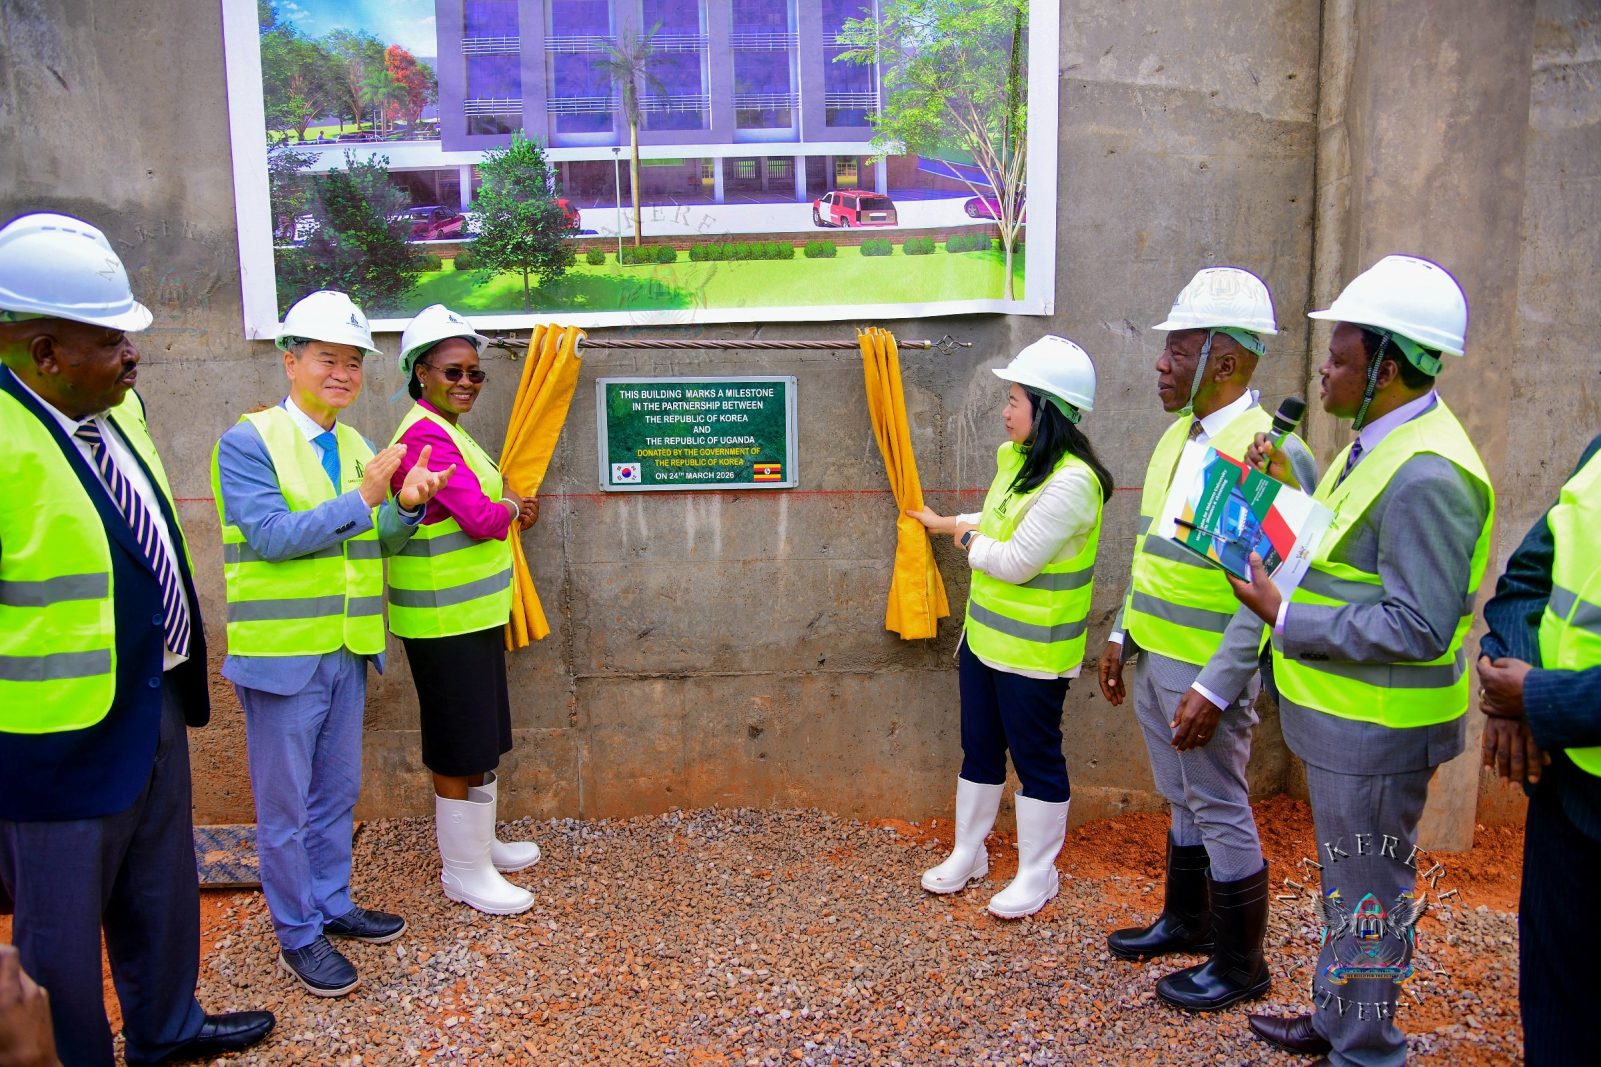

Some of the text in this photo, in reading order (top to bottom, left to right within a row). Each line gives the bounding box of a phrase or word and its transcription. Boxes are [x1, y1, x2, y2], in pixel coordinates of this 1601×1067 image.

[620, 390, 640, 398] THIS
[641, 390, 681, 398] BUILDING
[726, 389, 773, 397] MILESTONE
[643, 402, 660, 410] THE
[662, 402, 720, 410] PARTNERSHIP
[723, 401, 763, 409] BETWEEN
[645, 415, 662, 423] THE
[664, 415, 704, 423] REPUBLIC
[665, 437, 705, 445] REPUBLIC
[637, 449, 671, 457] DONATED
